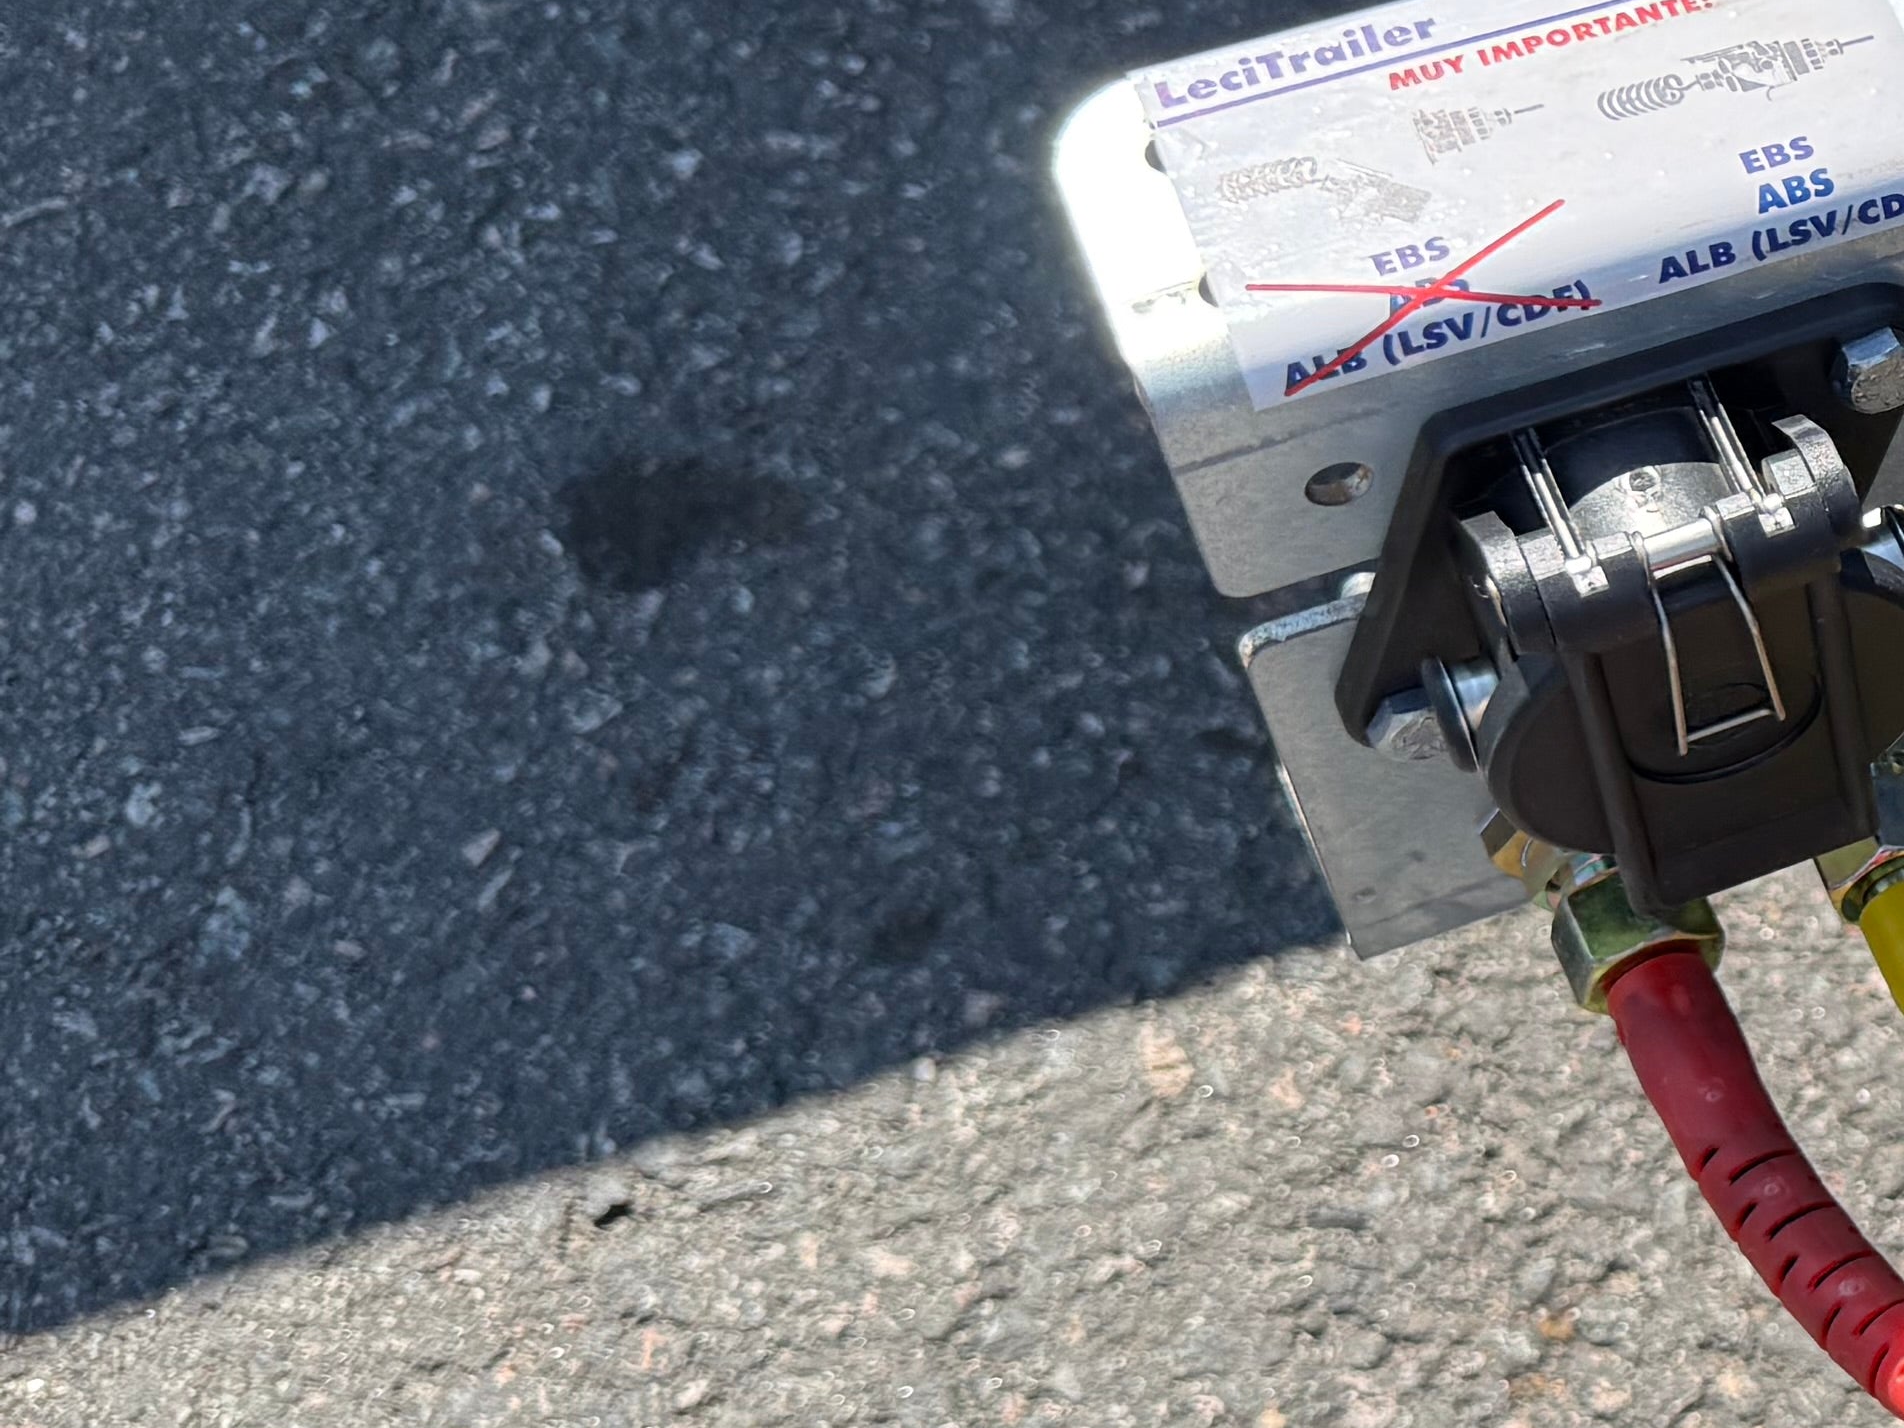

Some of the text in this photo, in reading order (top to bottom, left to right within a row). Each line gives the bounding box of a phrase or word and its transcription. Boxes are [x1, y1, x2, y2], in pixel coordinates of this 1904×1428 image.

[1153, 17, 1436, 109] LeciTrailer
[1389, 54, 1465, 92] MUY
[1738, 135, 1815, 174] EBS
[1758, 167, 1835, 214] ABS
[1370, 235, 1450, 277] EBS
[1658, 241, 1737, 284] ALB
[1285, 279, 1593, 394] ALB (LSV/CDF)
